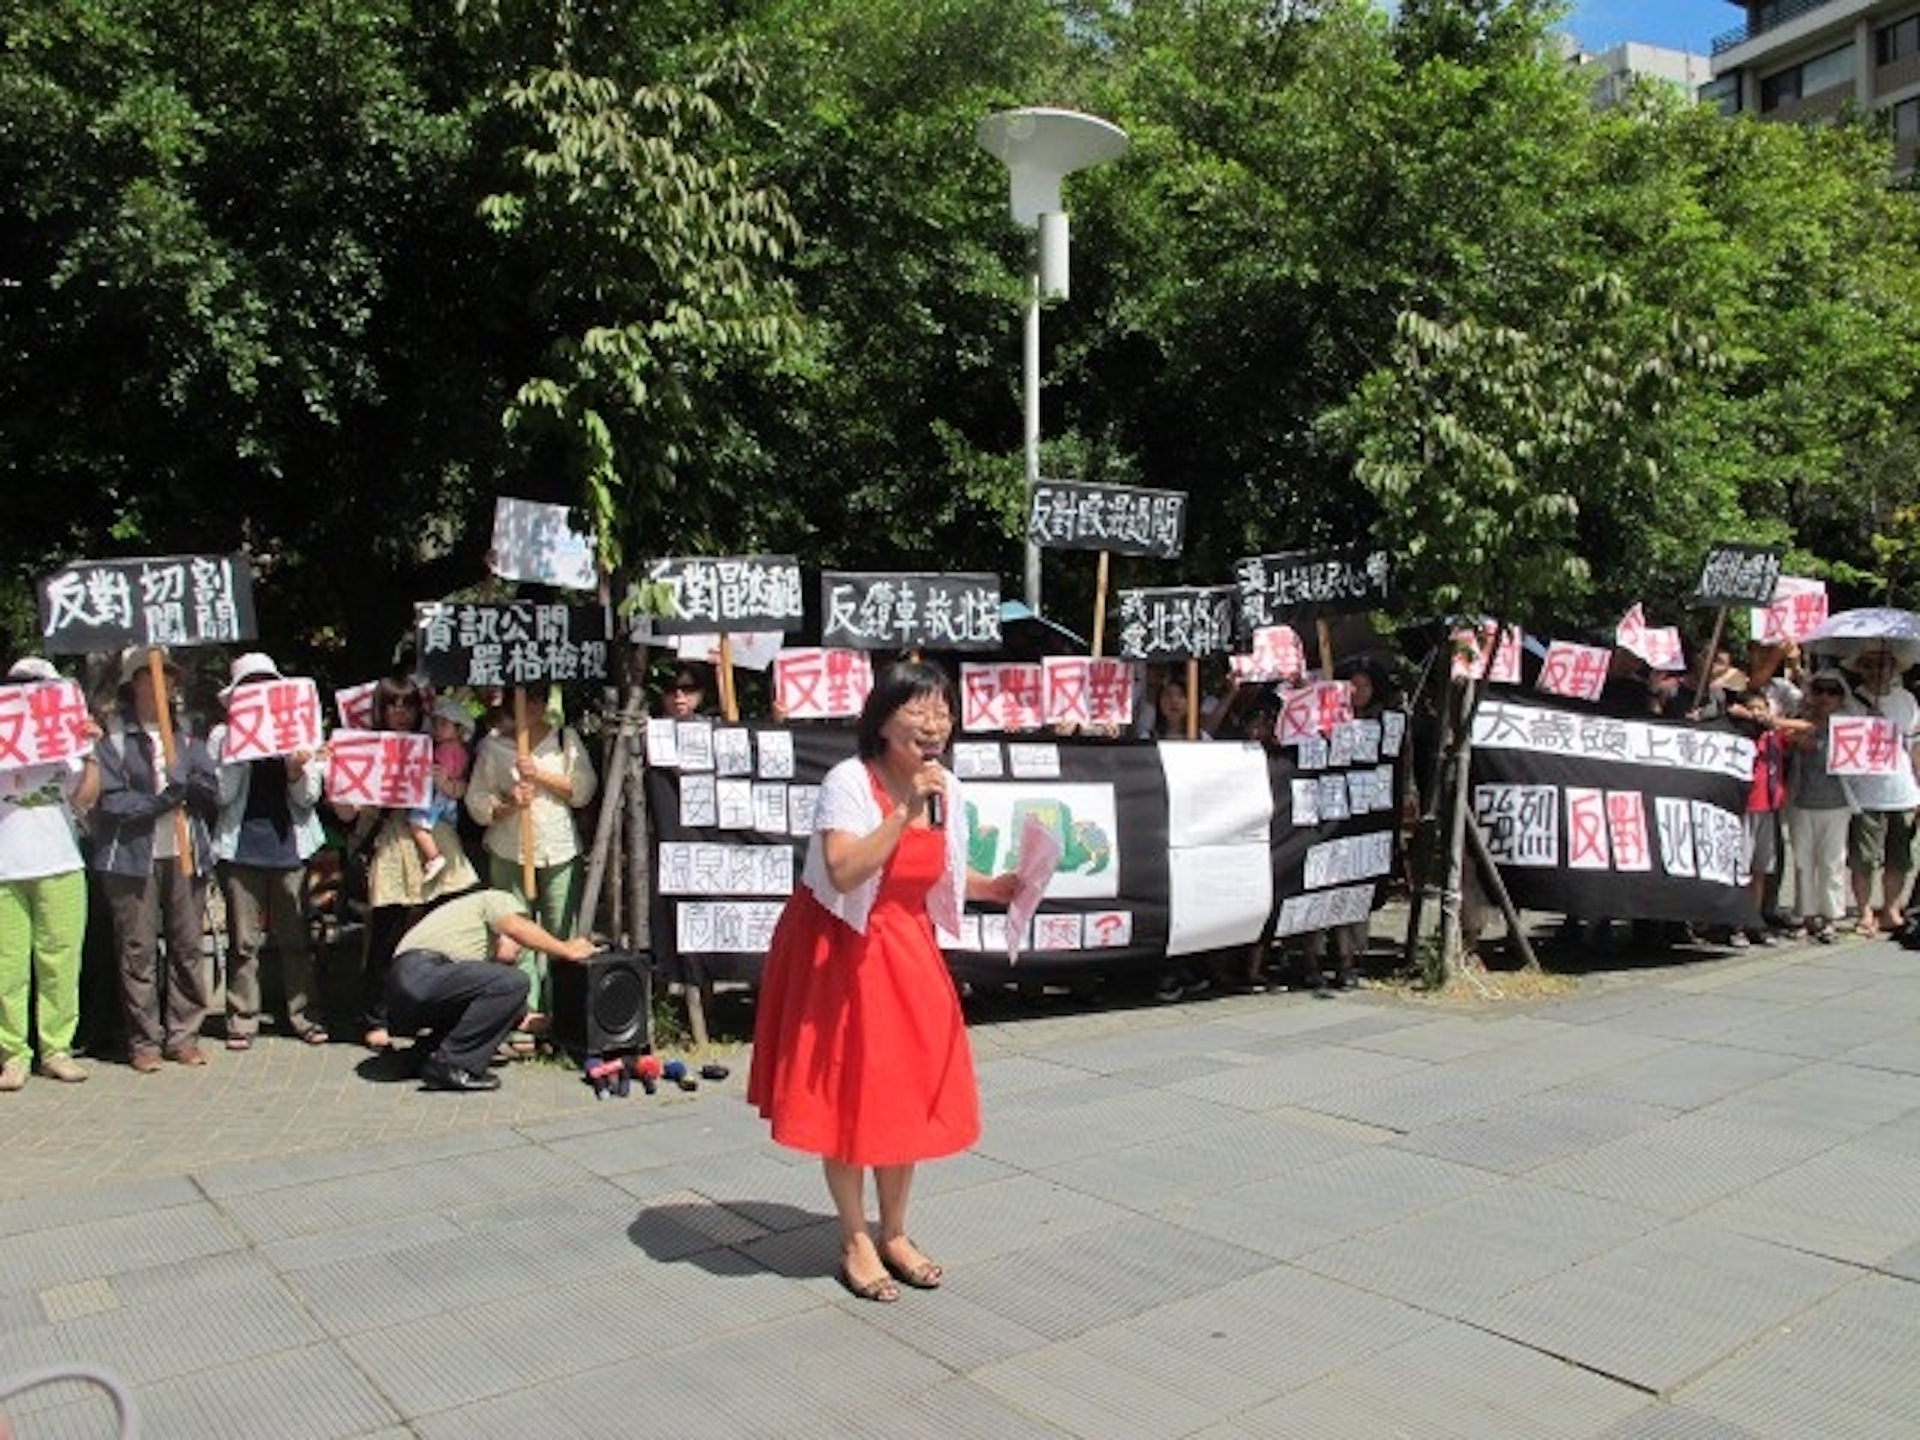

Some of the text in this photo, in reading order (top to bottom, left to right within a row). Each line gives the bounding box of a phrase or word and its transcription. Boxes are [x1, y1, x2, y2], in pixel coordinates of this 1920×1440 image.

[419, 603, 569, 653] 資訊公開
[467, 640, 608, 685] 嚴格檢視
[776, 650, 873, 714] 反對
[1543, 646, 1610, 698] 反對
[224, 682, 319, 761] 反對
[964, 669, 1043, 727] 反對
[1047, 662, 1131, 726] 反對
[328, 737, 430, 804] 反對
[1832, 722, 1900, 771] 反對
[1571, 791, 1647, 866] 反對
